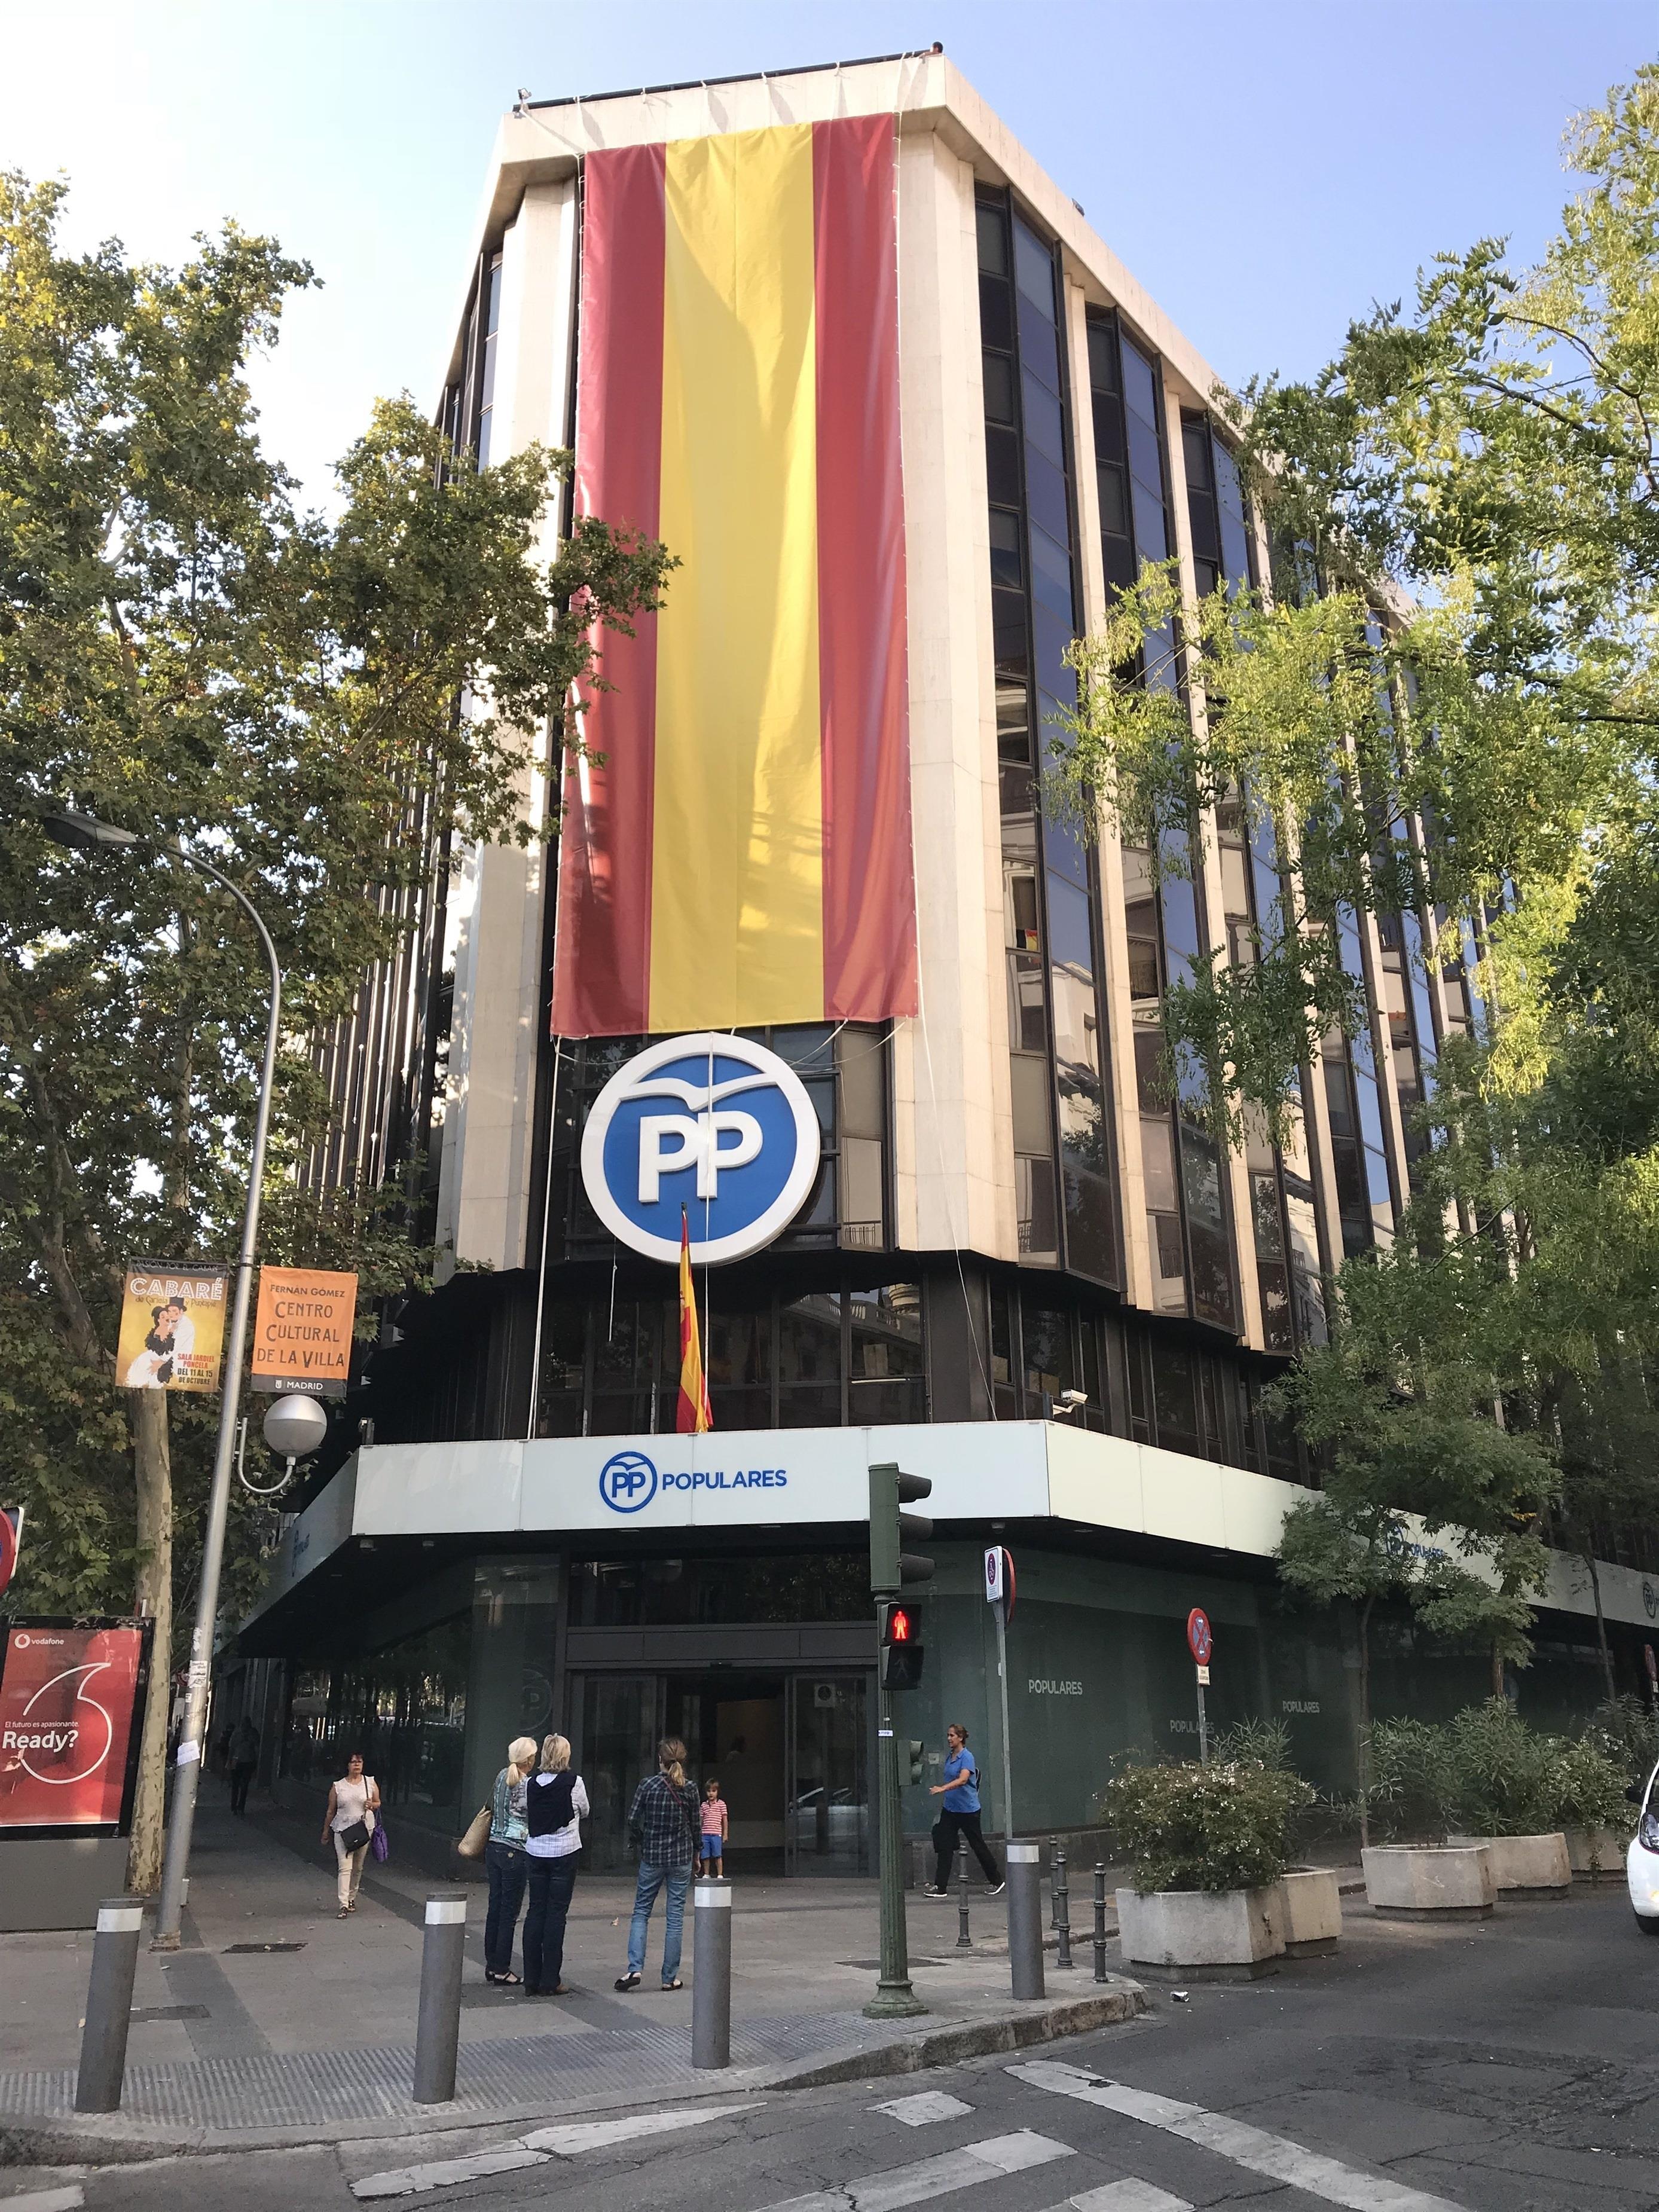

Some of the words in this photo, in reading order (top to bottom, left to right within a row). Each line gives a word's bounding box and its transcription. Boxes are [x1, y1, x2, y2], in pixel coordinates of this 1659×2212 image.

[638, 1110, 763, 1203] PP
[130, 1277, 223, 1300] CABARÉ
[270, 1284, 308, 1295] FERNÁN
[310, 1287, 345, 1297] GÓMEZ
[275, 1301, 333, 1318] CENTRO
[266, 1324, 340, 1342] CULTURAL
[183, 1361, 208, 1369] PONCELA
[193, 1354, 215, 1362] JARDIEL
[257, 1348, 275, 1362] DE
[280, 1349, 297, 1364] LA
[303, 1351, 344, 1368] VILLA
[287, 1381, 323, 1391] MADRID
[612, 1471, 646, 1498] PP
[662, 1469, 787, 1490] POPULARES
[1028, 1679, 1083, 1695] POPULARES
[1282, 1700, 1320, 1713] POPULARES
[41, 1721, 80, 1729] apasionante.
[1170, 1719, 1215, 1734] POPULAES
[2, 1730, 79, 1753] Ready?
